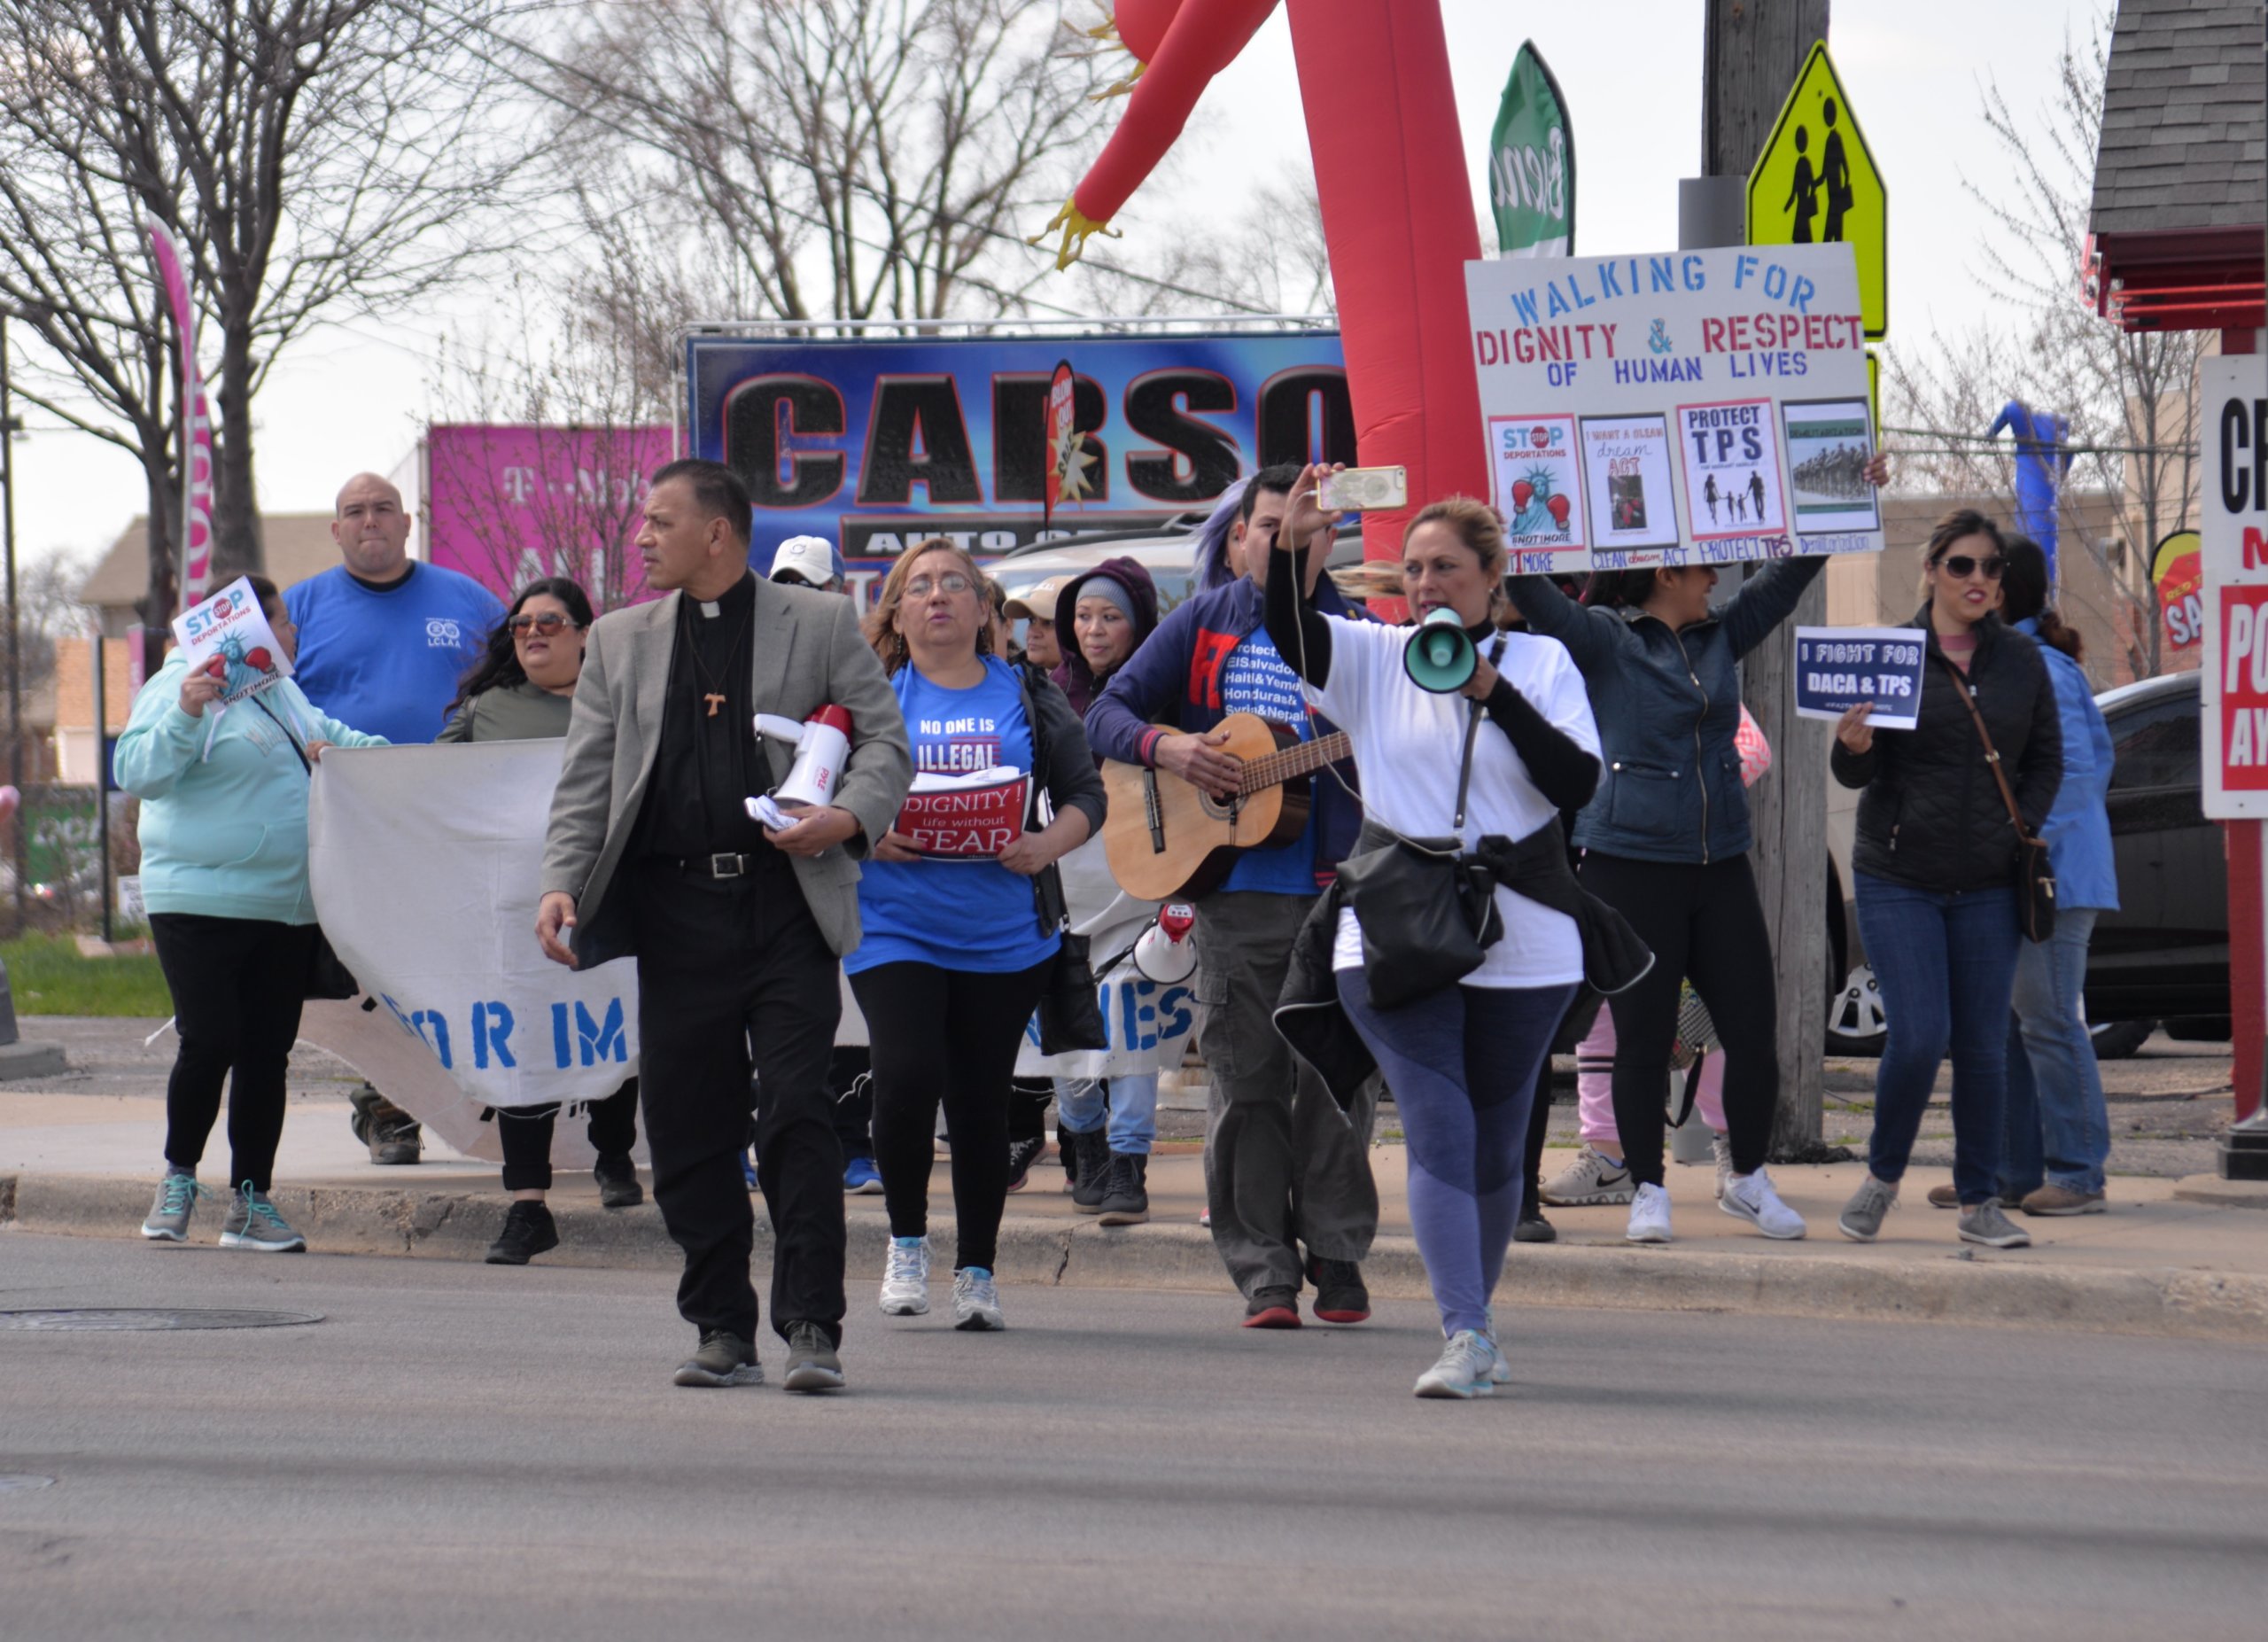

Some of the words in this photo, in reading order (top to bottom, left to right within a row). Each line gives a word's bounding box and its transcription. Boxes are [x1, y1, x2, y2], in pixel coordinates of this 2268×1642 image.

[1511, 256, 1705, 327] WALKING
[1735, 254, 1814, 314] FOR
[1476, 323, 1617, 365] DIGNITY
[1648, 318, 1673, 354] &
[1702, 312, 1862, 353] RESPECT
[1548, 362, 1577, 386] OF
[1615, 357, 1703, 385] HUMAN
[1730, 351, 1807, 377] LIVES
[1058, 401, 1073, 429] OUT
[1689, 406, 1760, 428] PROTECT
[1503, 426, 1564, 448] STOP
[1531, 432, 1549, 442] STOP
[1691, 426, 1762, 463] TPS
[1503, 449, 1566, 459] DEPORTATIONS
[1597, 442, 1652, 458] dream
[1608, 458, 1641, 476] ACT
[865, 532, 1016, 553] AUTO
[1699, 537, 1760, 563] PROTECT
[1760, 534, 1793, 557] TPS
[1663, 548, 1689, 567] ACT
[186, 589, 244, 636] STOP
[214, 601, 232, 617] STOP
[191, 606, 252, 646] DEPORTATIONS
[428, 637, 462, 649] LCLAA
[1237, 643, 1277, 658] rotect
[1801, 643, 1808, 662] I
[1816, 643, 1876, 663] FIGHT
[1883, 645, 1920, 665] FOR
[1225, 672, 1301, 691] Haiti&Yeme
[1807, 672, 1858, 694] DACA
[1860, 676, 1875, 694] &
[1877, 673, 1912, 696] TPS
[920, 720, 941, 735] NO
[946, 718, 975, 735] ONE
[980, 719, 995, 732] IS
[918, 744, 998, 771] ILLEGAL
[904, 789, 1010, 813] DIGNITY
[952, 816, 1006, 828] without
[912, 829, 1014, 852] FEAR
